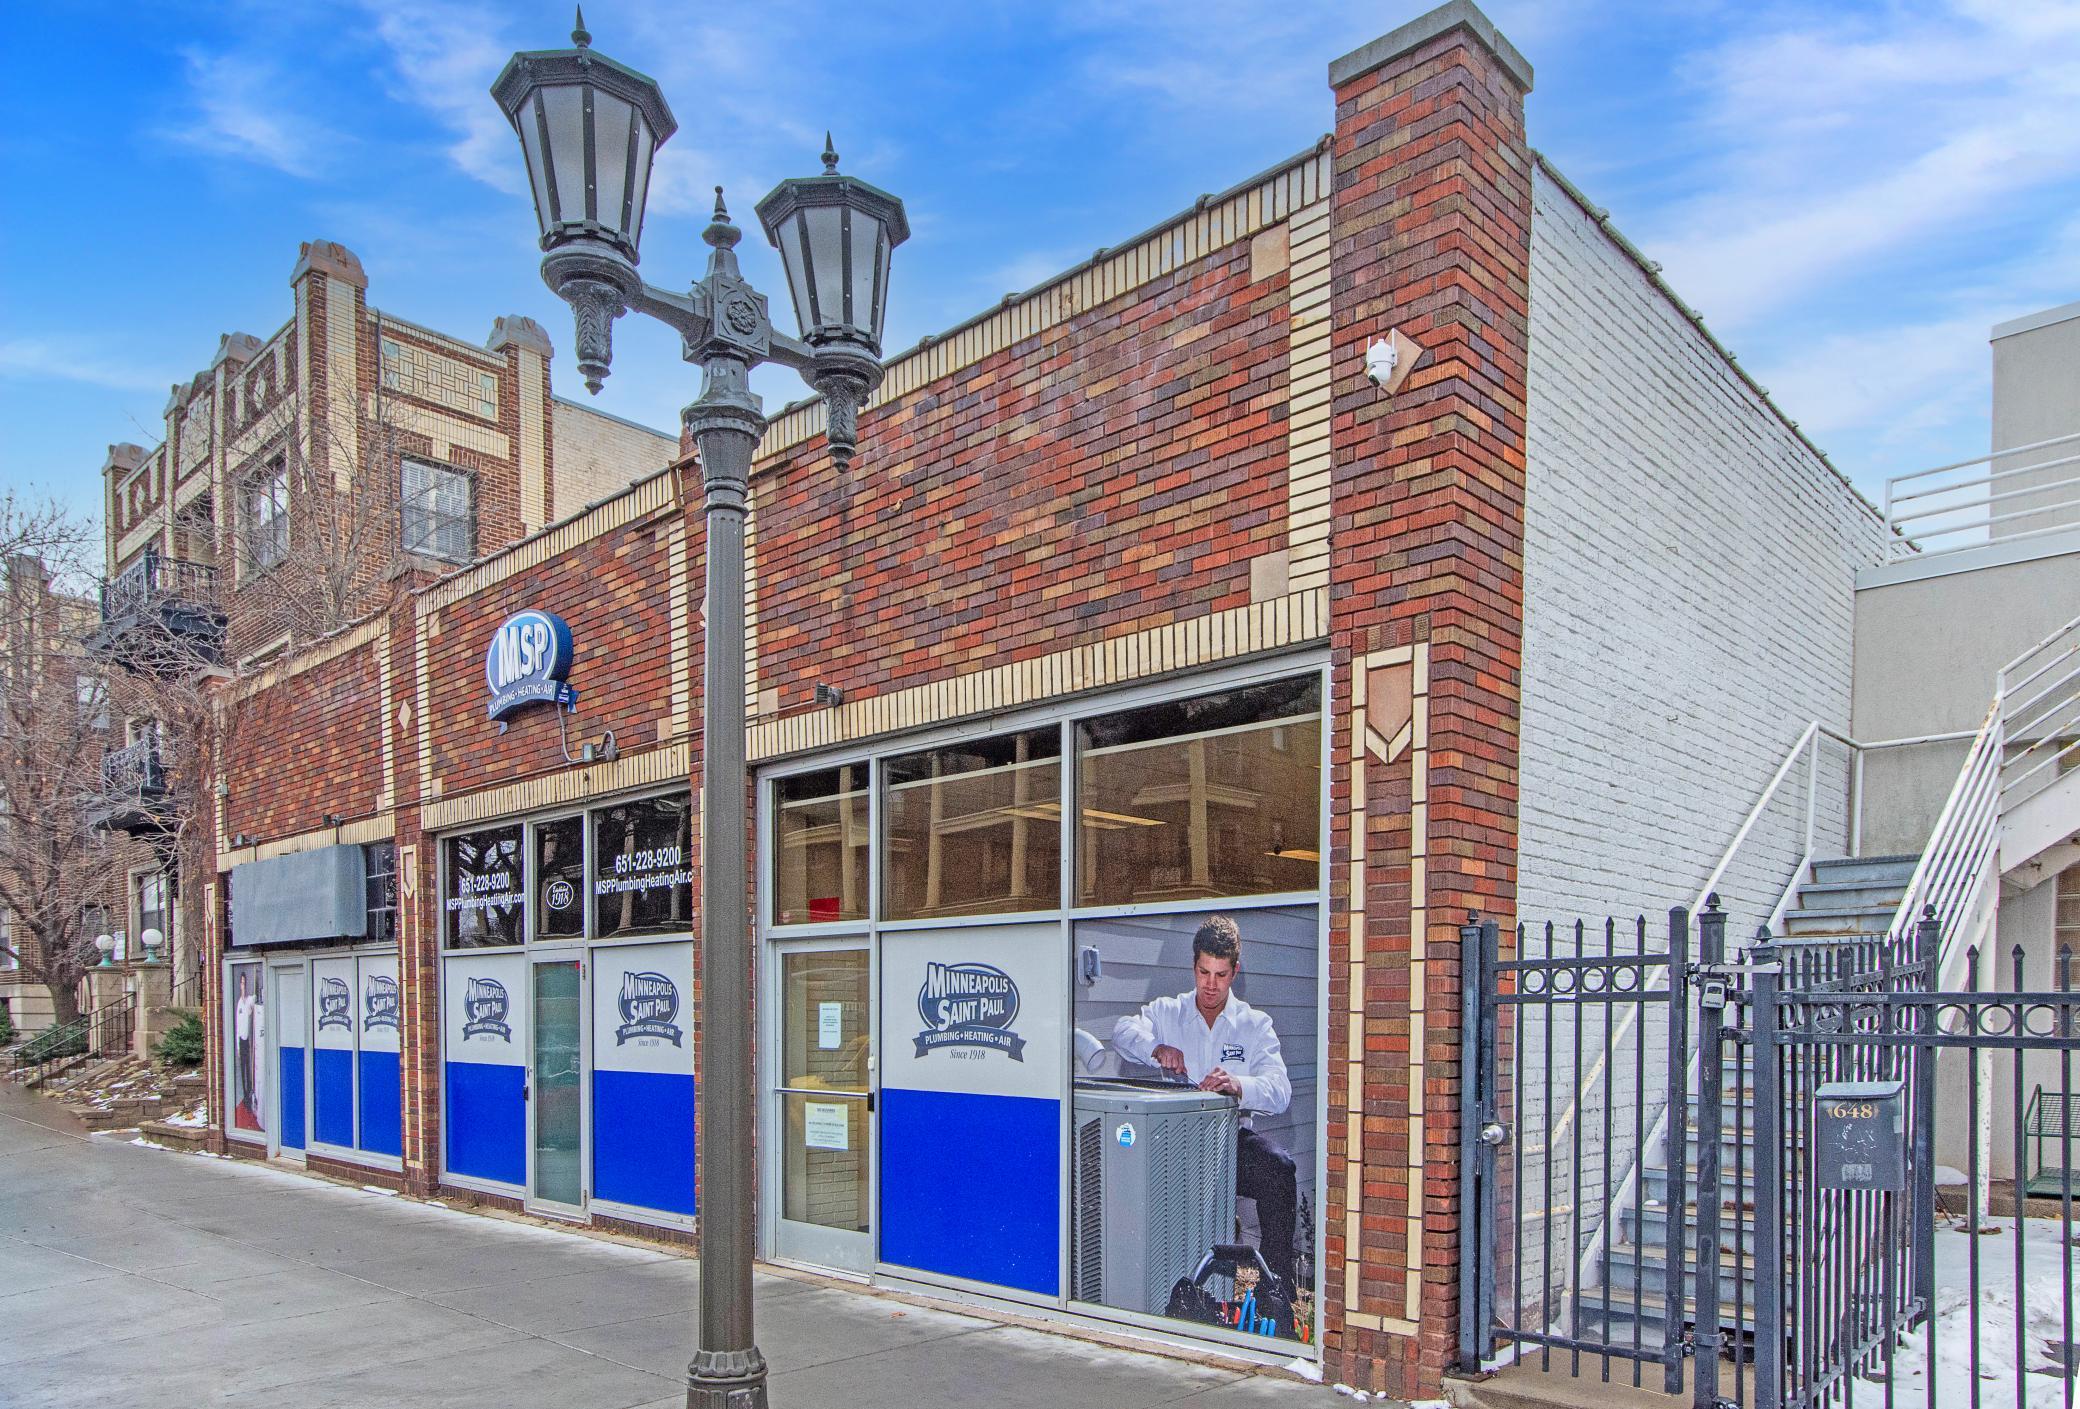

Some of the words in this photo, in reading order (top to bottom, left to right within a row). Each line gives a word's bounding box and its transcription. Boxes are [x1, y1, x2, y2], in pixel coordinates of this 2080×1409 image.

[499, 623, 548, 688] MSP
[490, 689, 516, 714] PLUMBING
[517, 684, 541, 697] HEATING
[543, 684, 553, 695] AIR
[615, 846, 680, 874] 651-228-9200
[461, 872, 510, 893] 651-228-9200
[551, 892, 569, 905] 1918
[624, 973, 673, 1000] MINNEAPOLIS
[927, 964, 1009, 999] MINNEAPOLIS
[630, 1000, 654, 1025] SAINT
[655, 998, 670, 1016] PAUL
[937, 999, 977, 1031] SAINT
[980, 997, 1004, 1020] PAUL
[622, 1025, 644, 1035] PLUMBING
[646, 1025, 665, 1034] HEATING
[667, 1028, 675, 1037] AIR
[925, 1031, 960, 1044] PLUMBING
[964, 1031, 994, 1043] HEATING
[998, 1036, 1011, 1047] AIR
[949, 1049, 968, 1060] Since
[969, 1049, 986, 1060] 1918
[1833, 1102, 1873, 1119] 648
